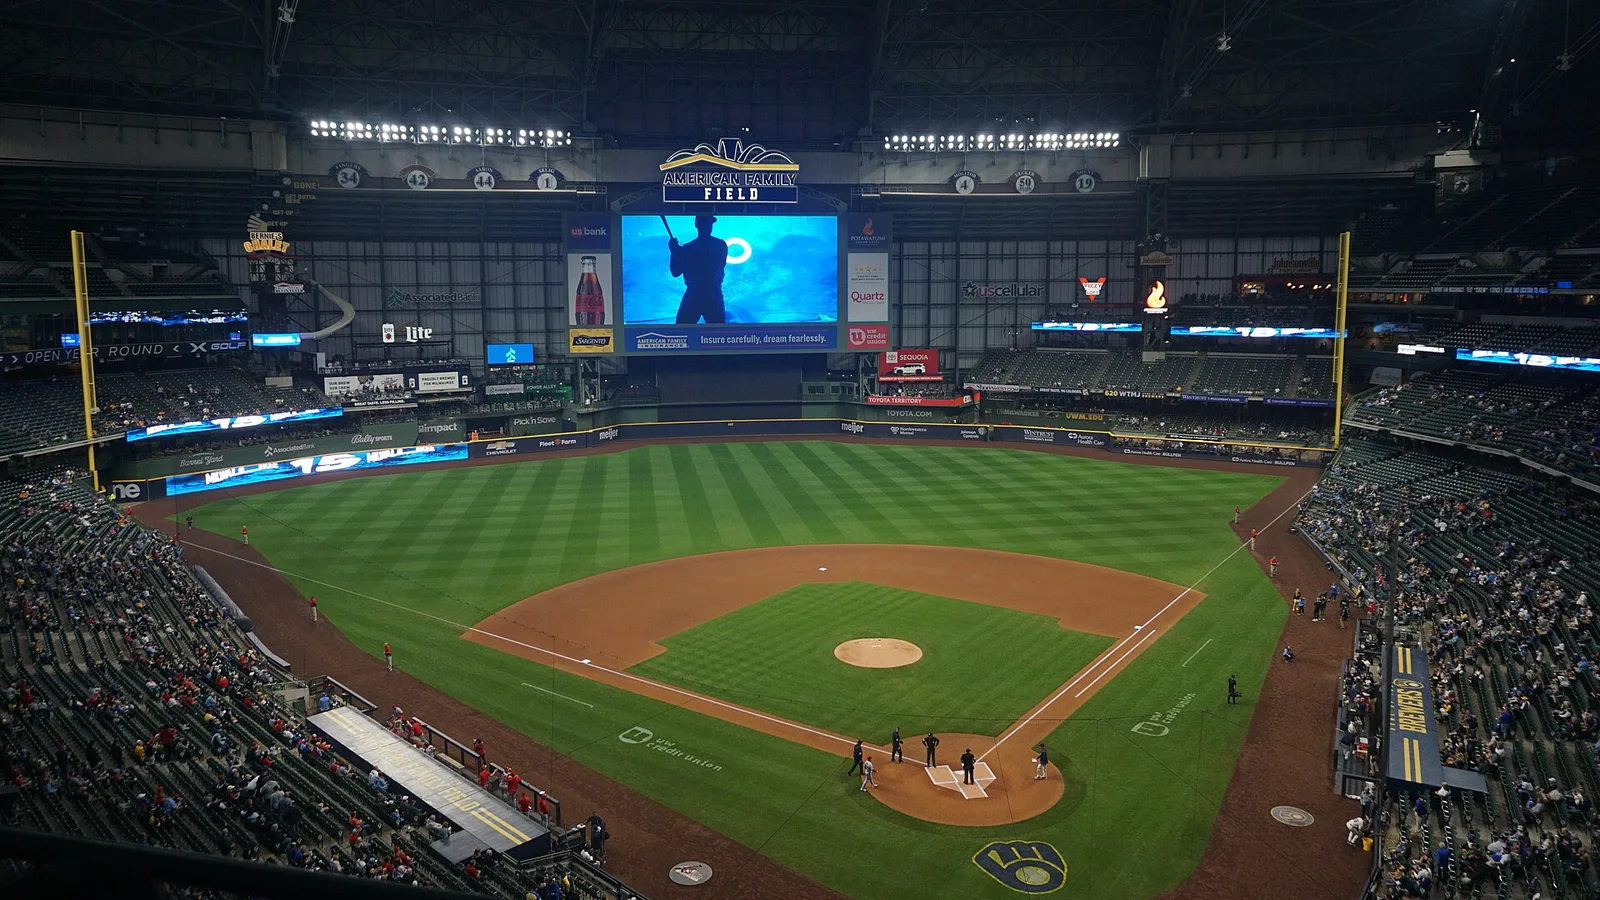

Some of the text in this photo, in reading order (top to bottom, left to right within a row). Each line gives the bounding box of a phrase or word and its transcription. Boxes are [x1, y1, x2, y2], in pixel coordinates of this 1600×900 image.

[340, 172, 358, 184] 34
[409, 174, 426, 186] 42
[476, 176, 493, 187] 44
[544, 178, 551, 188] 1
[663, 172, 797, 186] AMERICAN FAMILY
[1019, 178, 1031, 187] 50
[1078, 178, 1092, 190] 19
[960, 180, 967, 190] 4
[704, 188, 758, 200] FIELD
[250, 232, 283, 240] BERNIE'S
[584, 227, 607, 236] bank
[244, 239, 290, 253] CHALET
[1272, 257, 1320, 270] Johnsonville
[978, 284, 1044, 297] uscellular
[850, 291, 884, 303] Quartz
[405, 326, 432, 342] Lite
[700, 334, 826, 345] Insure carefully, dream fearlessly.
[211, 342, 246, 350] GOLF
[25, 344, 163, 363] OPEN YER ROUND
[514, 417, 529, 425] Pick
[1066, 412, 1104, 420] UWM.EDU
[841, 422, 864, 434] meijer
[351, 434, 375, 444] Bally
[600, 429, 619, 440] meijer
[180, 455, 224, 467] Barrel Yard
[1397, 688, 1427, 733] BREWERS
[656, 738, 675, 746] uw
[647, 742, 722, 771] credit union
[438, 786, 480, 811] FIELD
